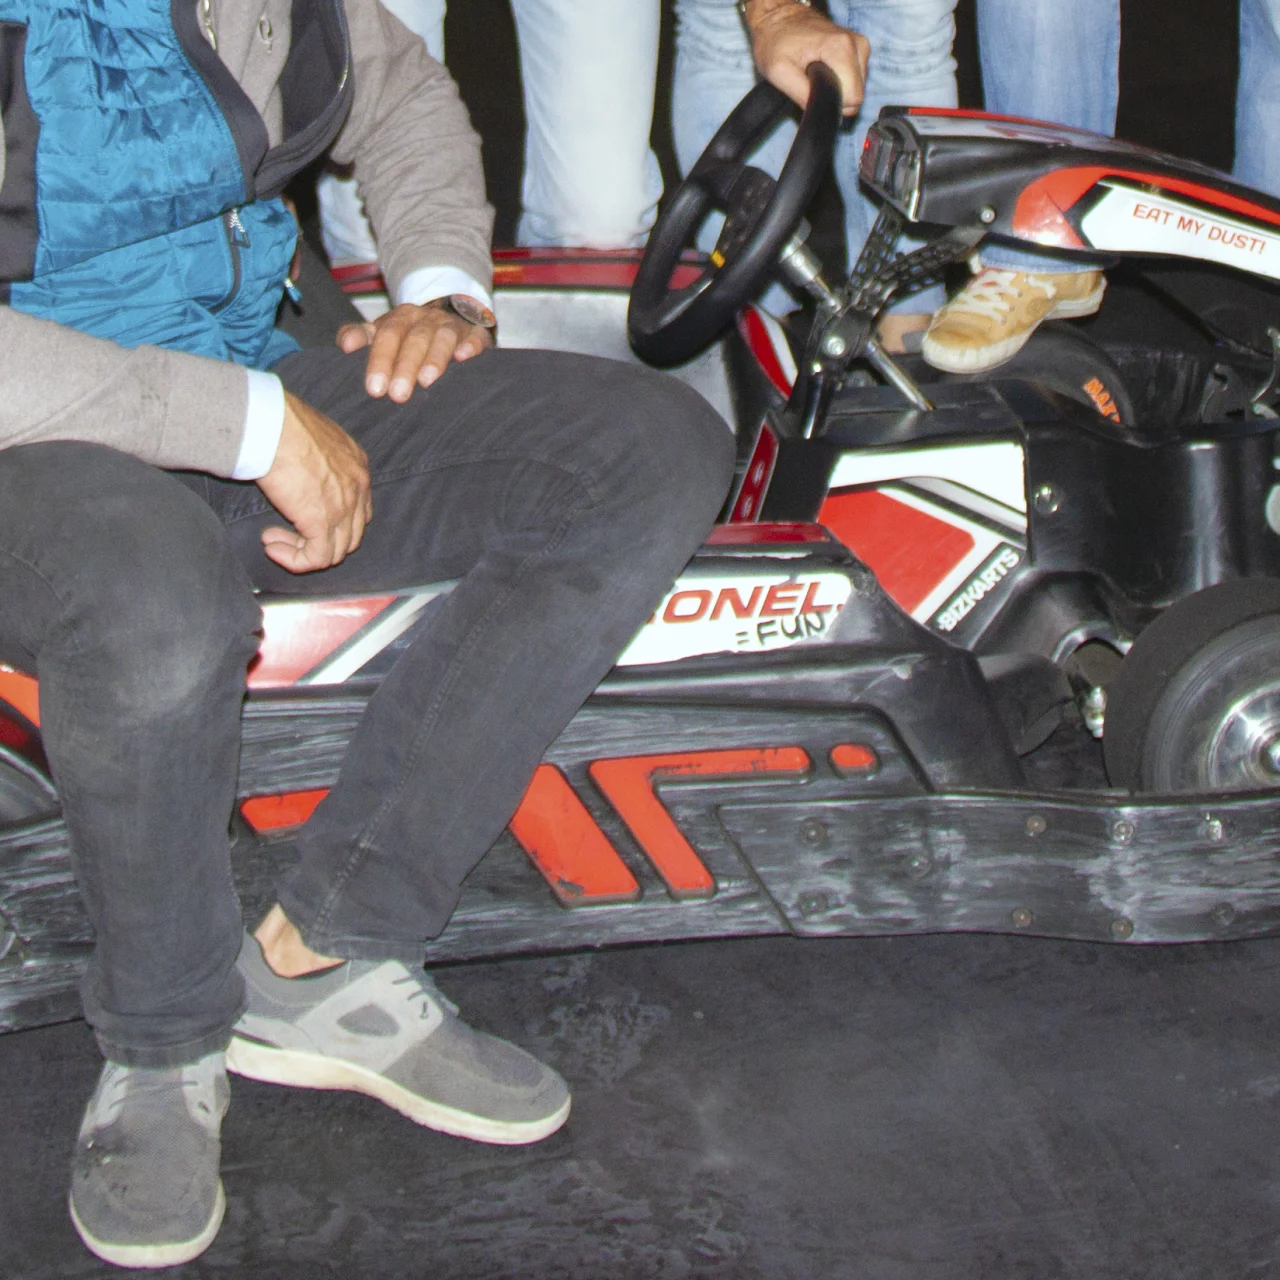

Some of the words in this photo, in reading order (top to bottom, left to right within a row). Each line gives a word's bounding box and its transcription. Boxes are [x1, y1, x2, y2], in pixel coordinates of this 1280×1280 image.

[1132, 203, 1174, 226] EAT
[1176, 215, 1206, 236] MY
[1207, 225, 1267, 255] DUST!
[937, 547, 1020, 632] BIZKARTS
